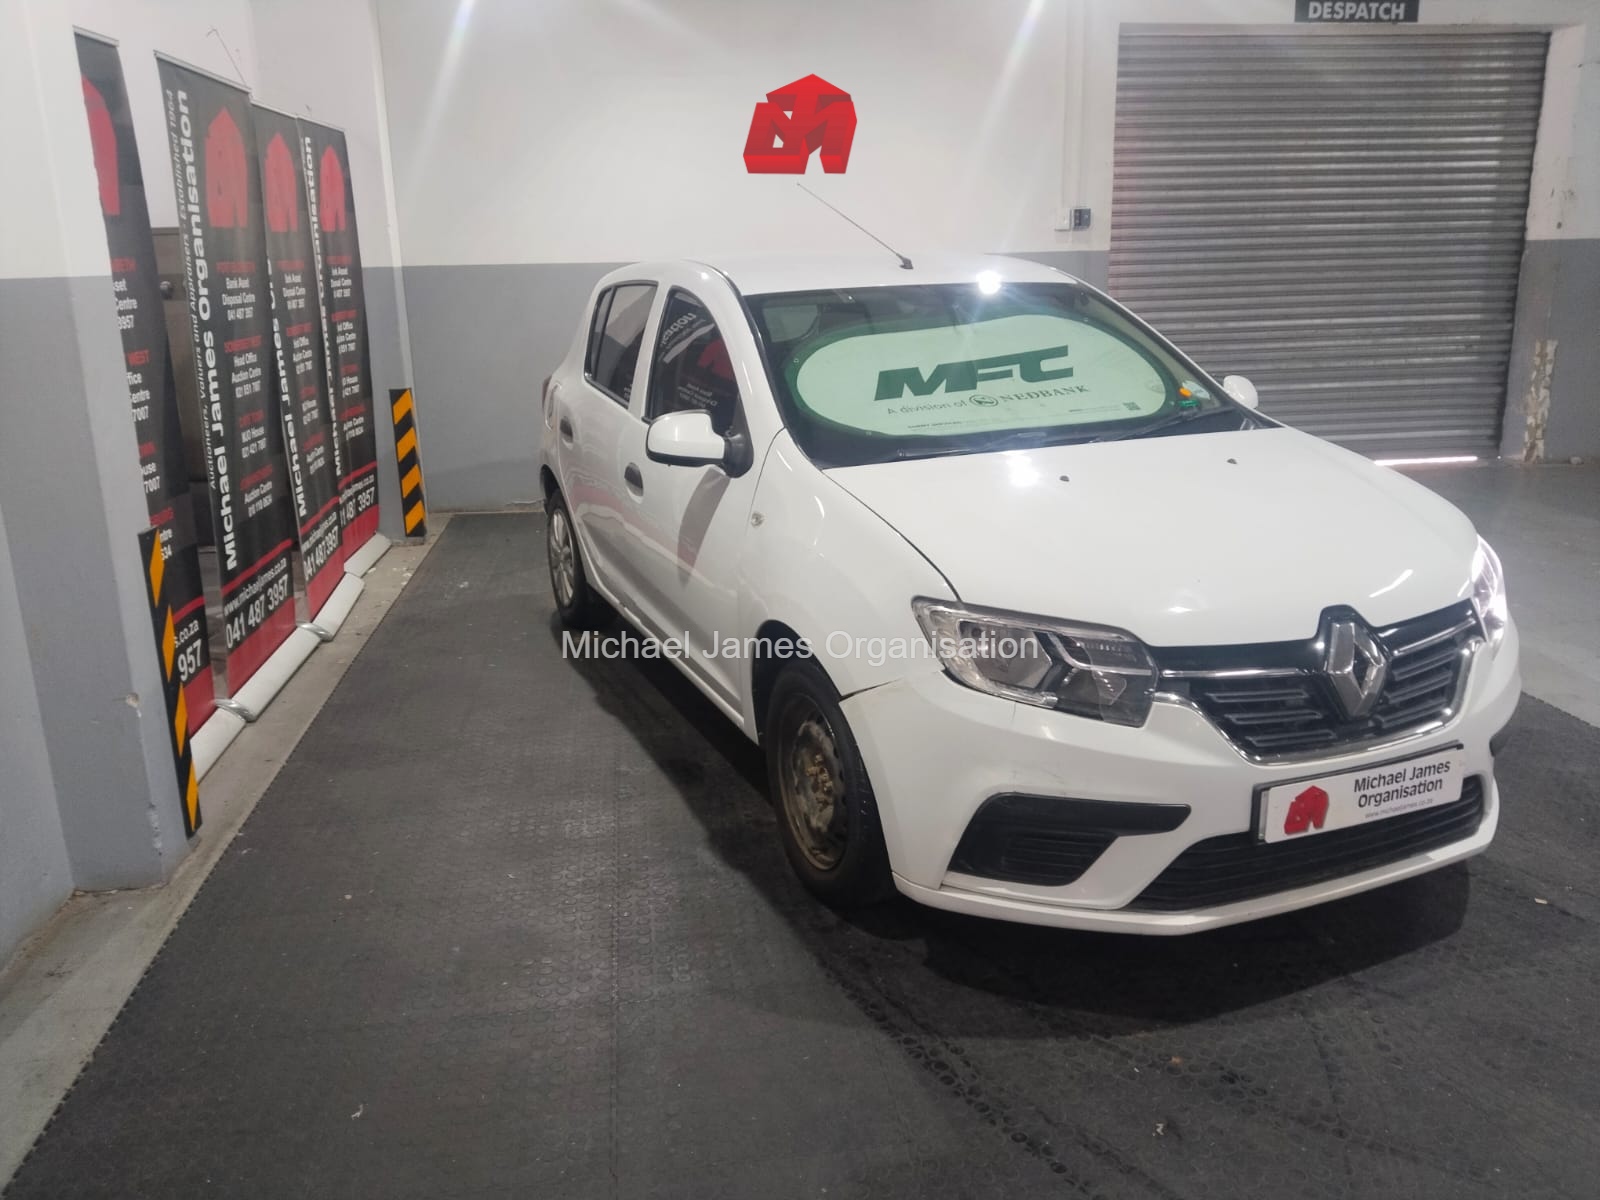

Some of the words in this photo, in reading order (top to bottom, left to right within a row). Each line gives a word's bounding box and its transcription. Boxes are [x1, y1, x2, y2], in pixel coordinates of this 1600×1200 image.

[1308, 2, 1405, 20] DESPATCH
[177, 90, 210, 321] Organisation
[203, 331, 224, 437] James
[272, 318, 290, 406] James
[873, 344, 1074, 401] MFC
[887, 406, 898, 415] A
[900, 401, 951, 415] division
[955, 399, 967, 408] of
[1000, 384, 1090, 403] NEDBANK
[284, 413, 307, 517] Michael
[213, 446, 237, 571] Michael
[357, 486, 375, 512] 3957
[225, 611, 246, 649] 041
[248, 593, 265, 628] 487
[267, 573, 288, 611] 3957
[178, 639, 202, 681] 957
[1353, 769, 1407, 793] Michael
[1409, 760, 1451, 781] James
[1358, 777, 1443, 809] Organisation
